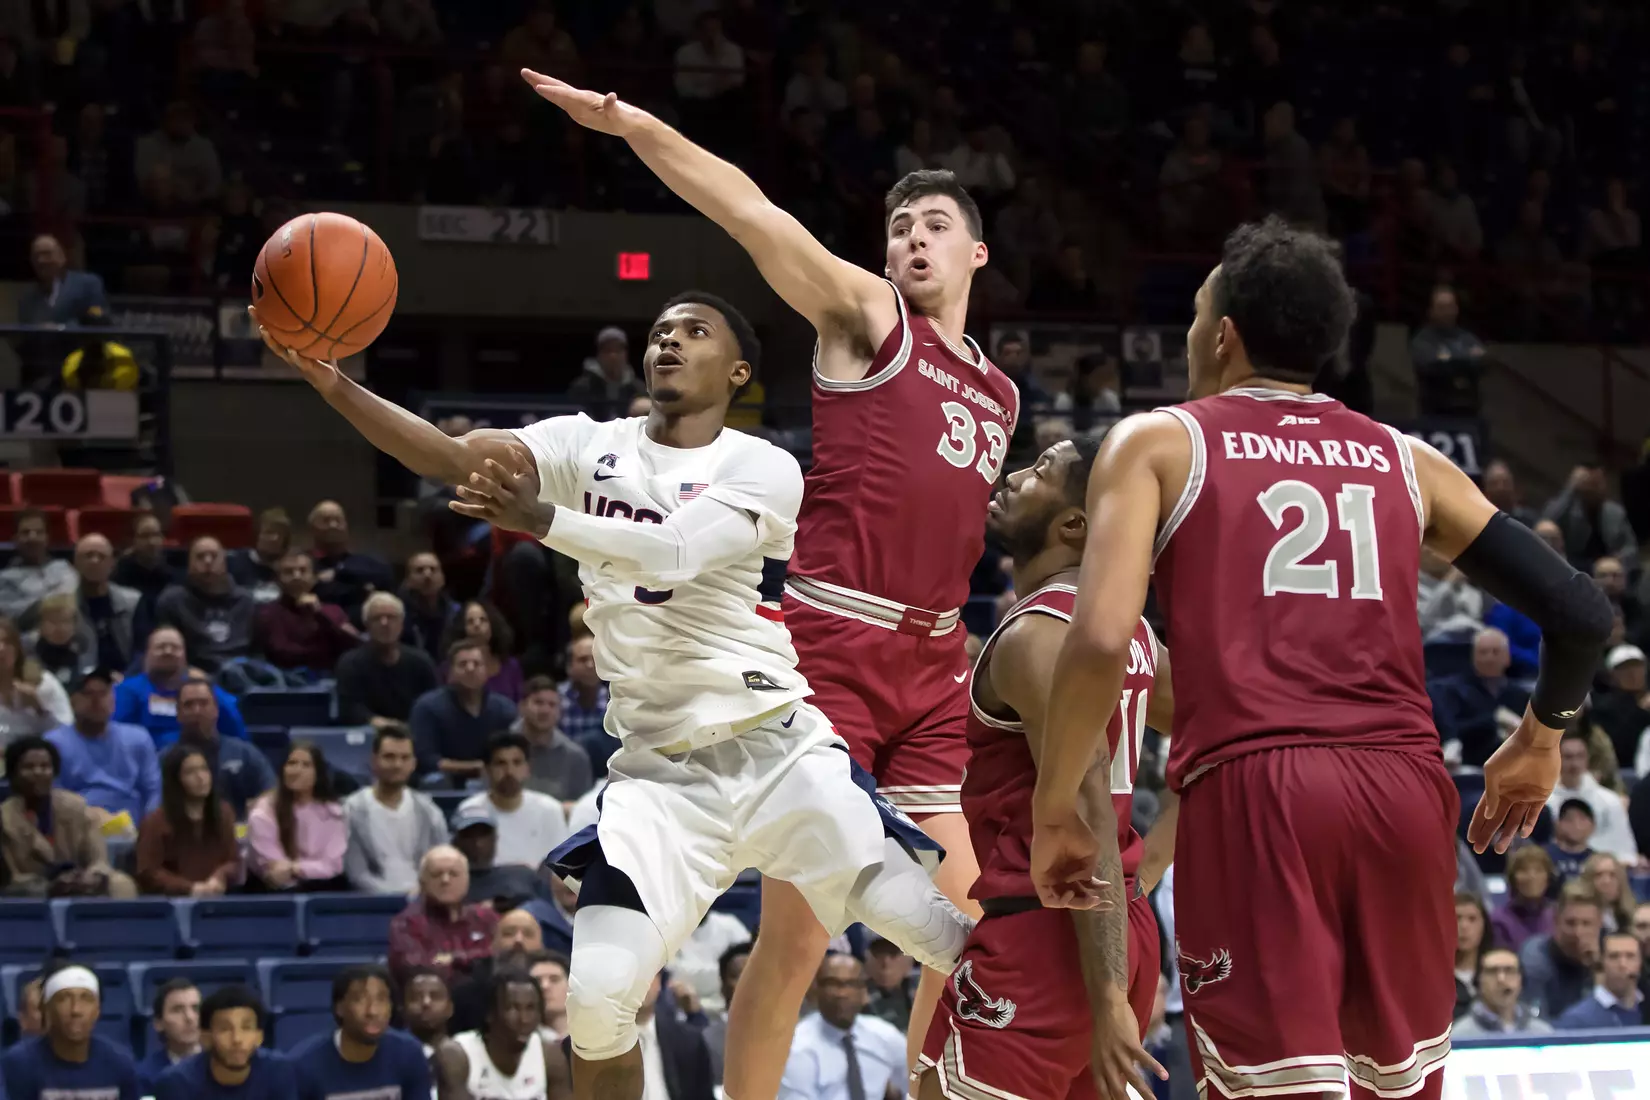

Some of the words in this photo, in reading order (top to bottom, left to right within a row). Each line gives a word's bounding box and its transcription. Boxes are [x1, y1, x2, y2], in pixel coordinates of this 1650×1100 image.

[425, 213, 468, 235] SEC
[917, 358, 960, 393] SAINT
[961, 383, 1014, 436] JOSEH
[936, 401, 1008, 485] 33
[1221, 431, 1391, 473] EDWARDS
[1409, 430, 1483, 474] 21
[1256, 479, 1384, 601] 21
